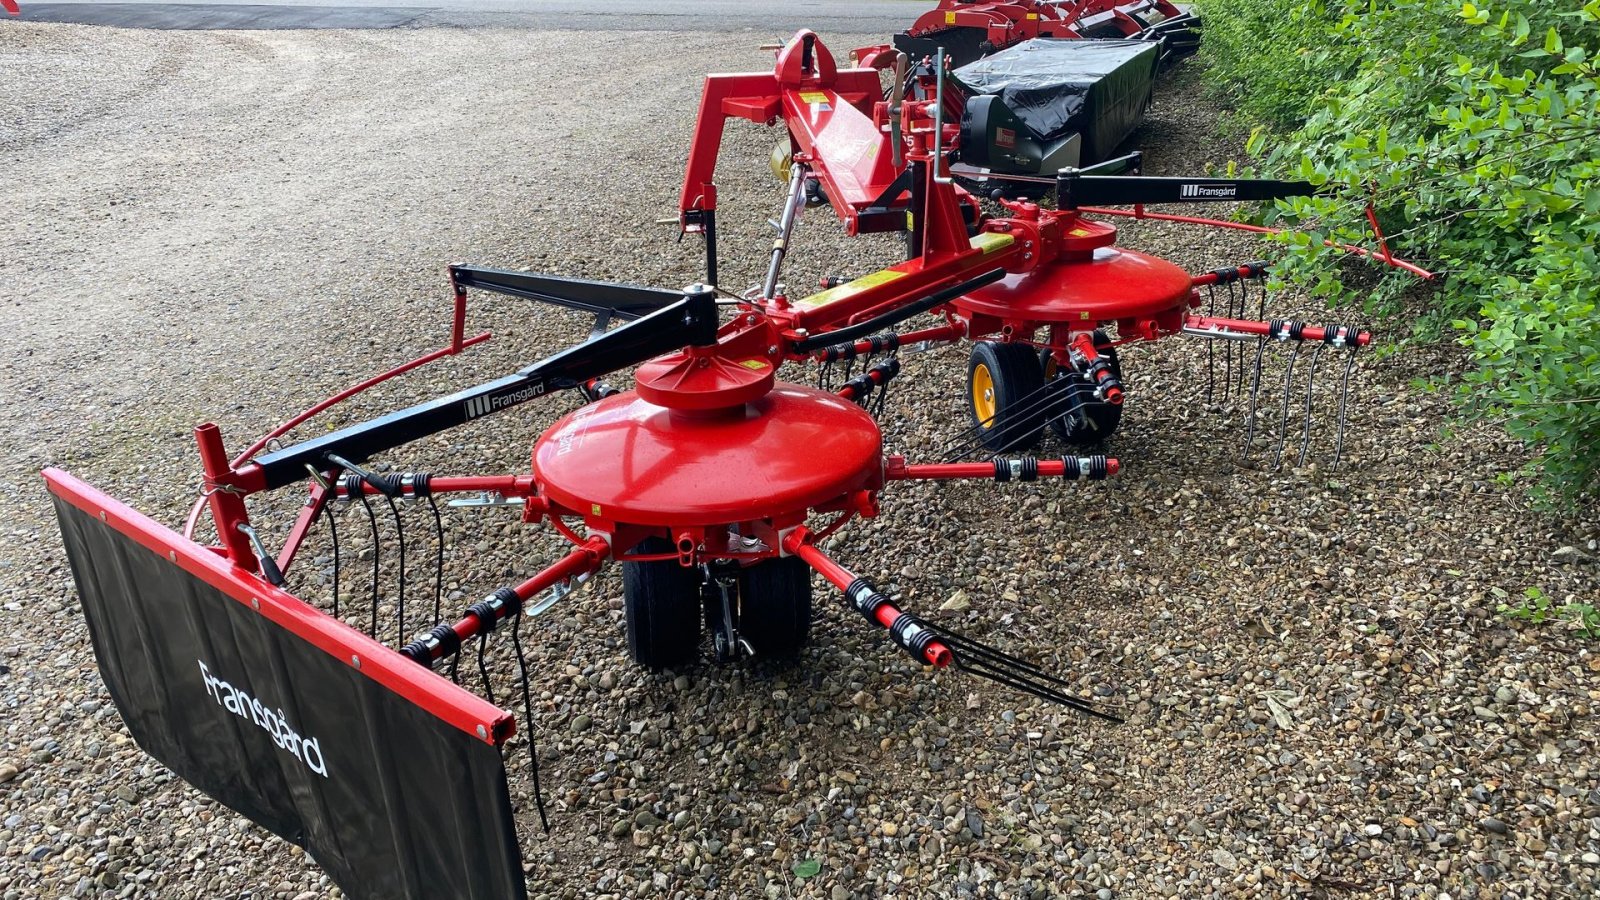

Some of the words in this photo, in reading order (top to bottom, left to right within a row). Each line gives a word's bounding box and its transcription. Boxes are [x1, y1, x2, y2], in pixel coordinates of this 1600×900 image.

[1198, 187, 1237, 197] Fransgård
[491, 382, 545, 409] Fransgård
[197, 658, 329, 778] Fransgård
